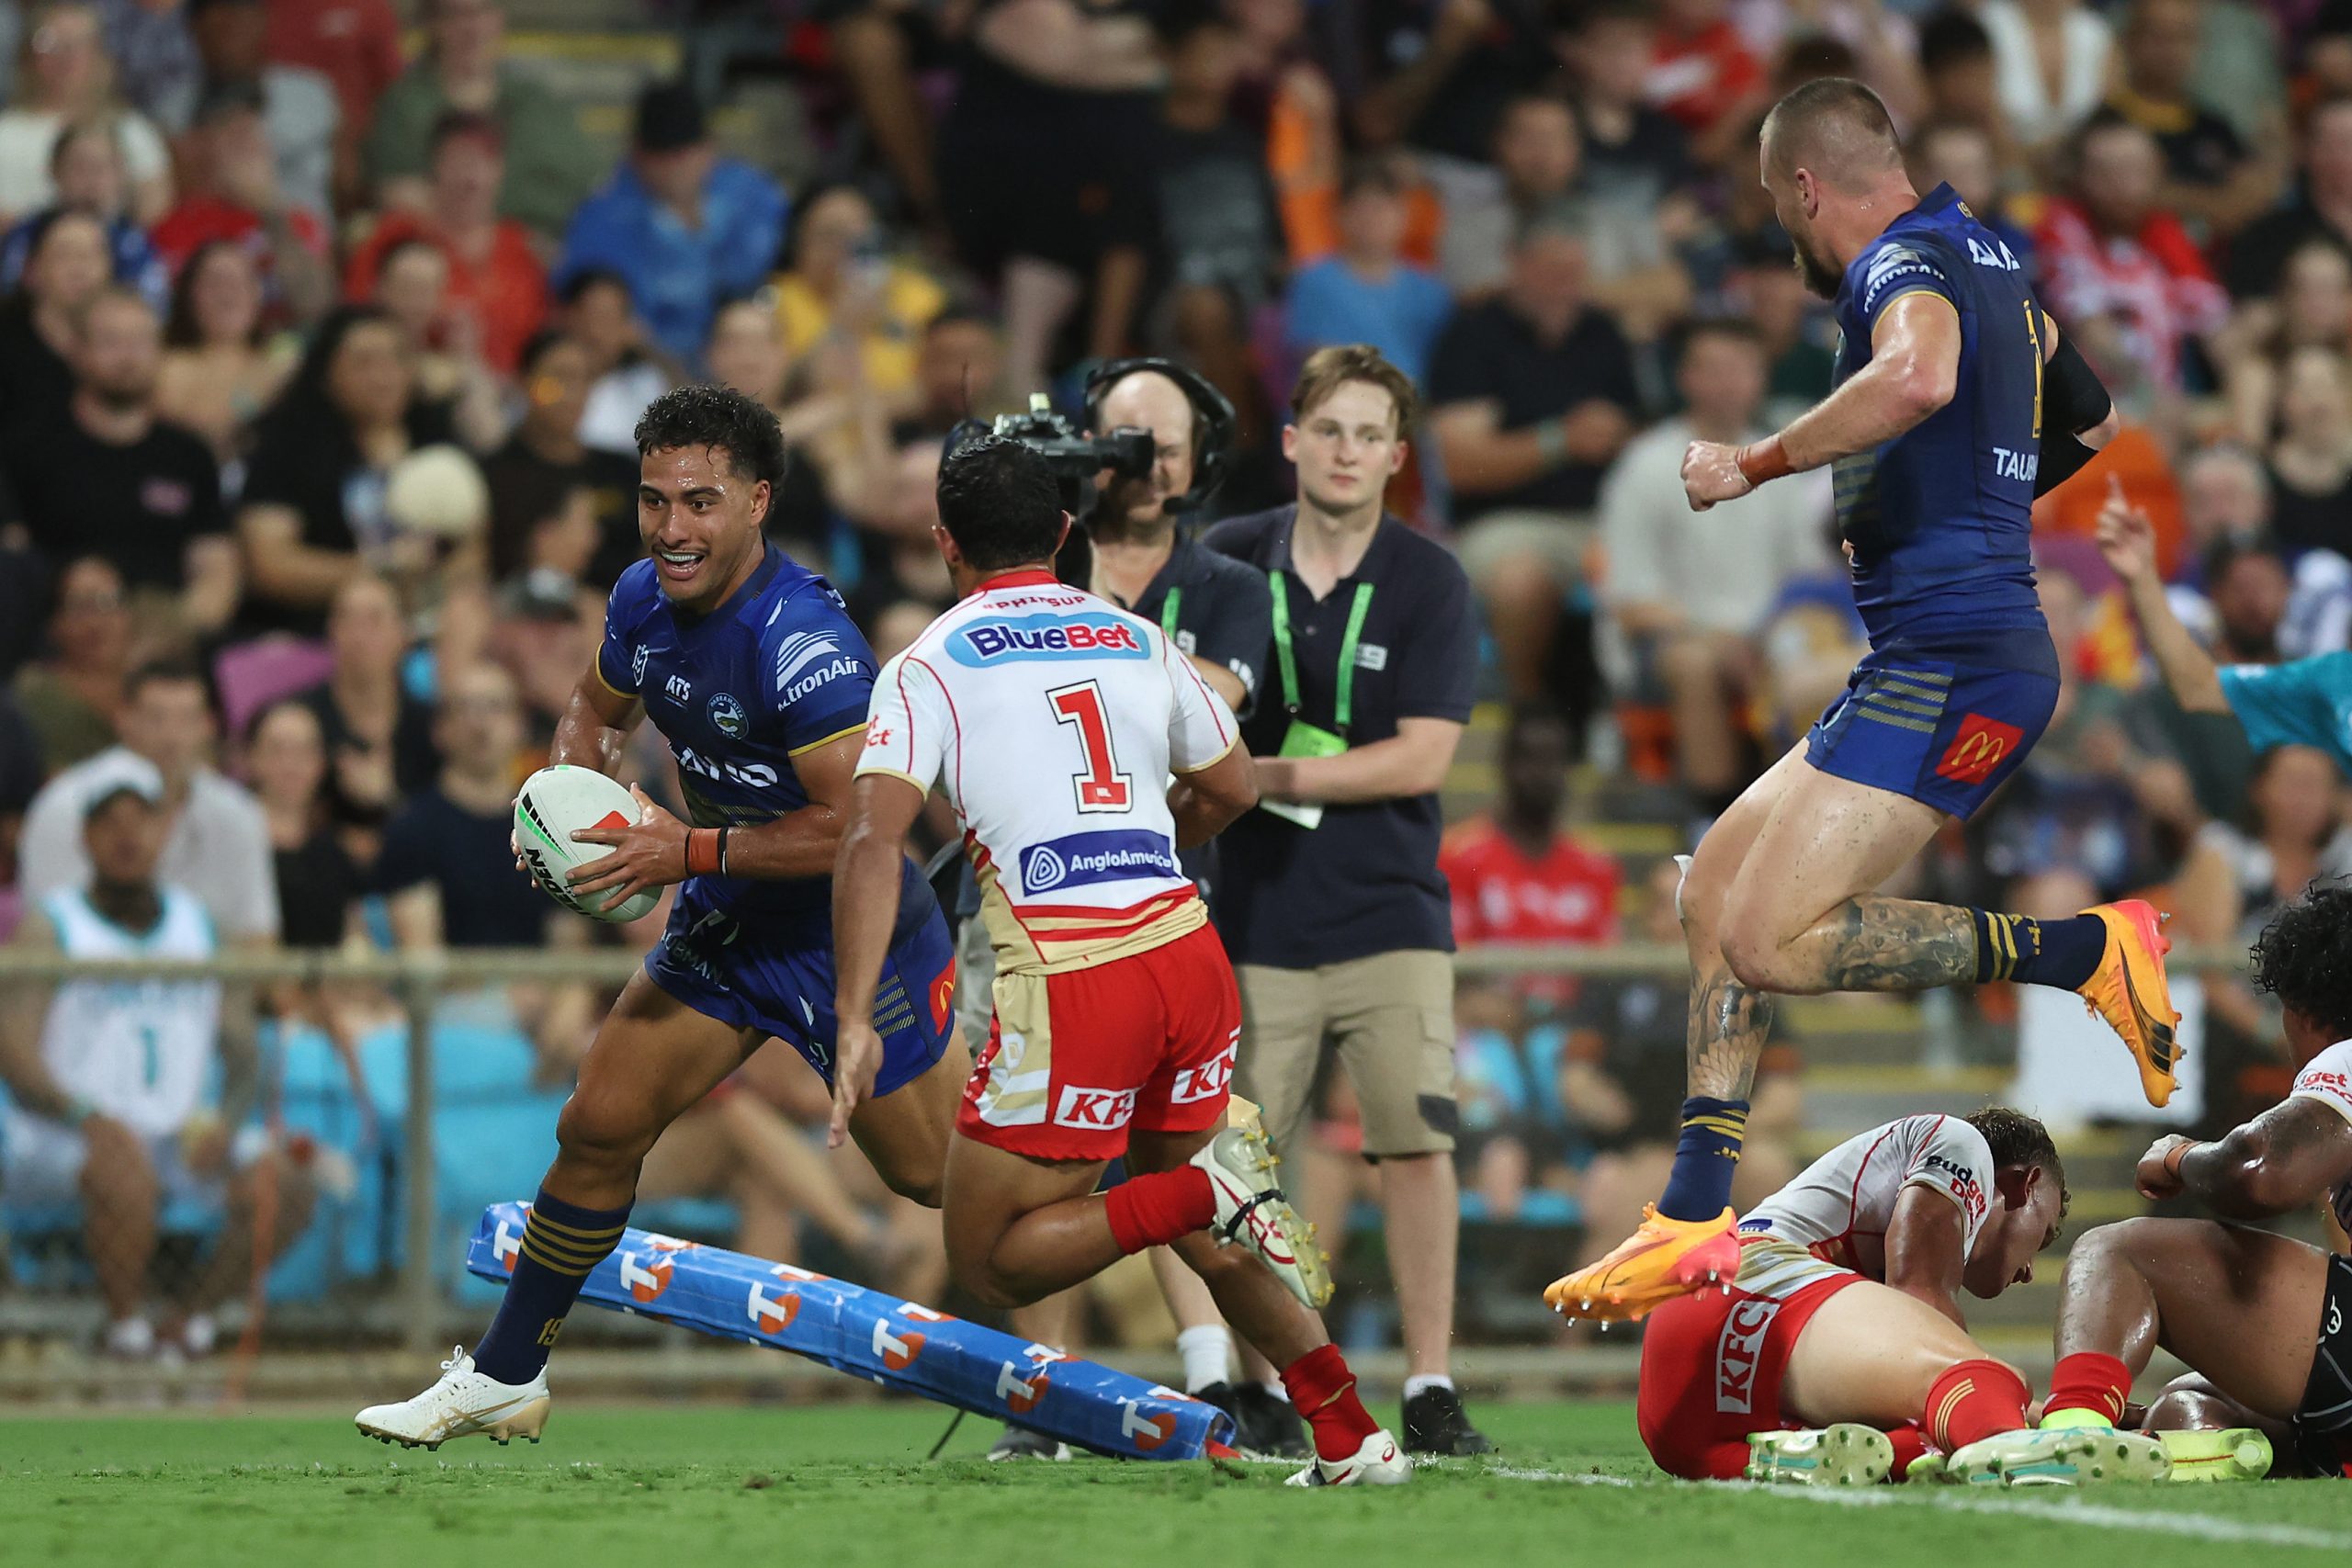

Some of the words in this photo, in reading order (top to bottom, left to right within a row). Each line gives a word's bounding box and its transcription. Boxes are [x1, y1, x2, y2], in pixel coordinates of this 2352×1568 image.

[965, 622, 1141, 659] BlueBet
[664, 674, 692, 701] ATS
[1045, 678, 1134, 816] 1
[748, 1280, 786, 1323] T
[872, 1317, 909, 1359] T
[1720, 1304, 1770, 1406] KFC
[996, 1359, 1035, 1401] T
[1122, 1401, 1161, 1439] T
